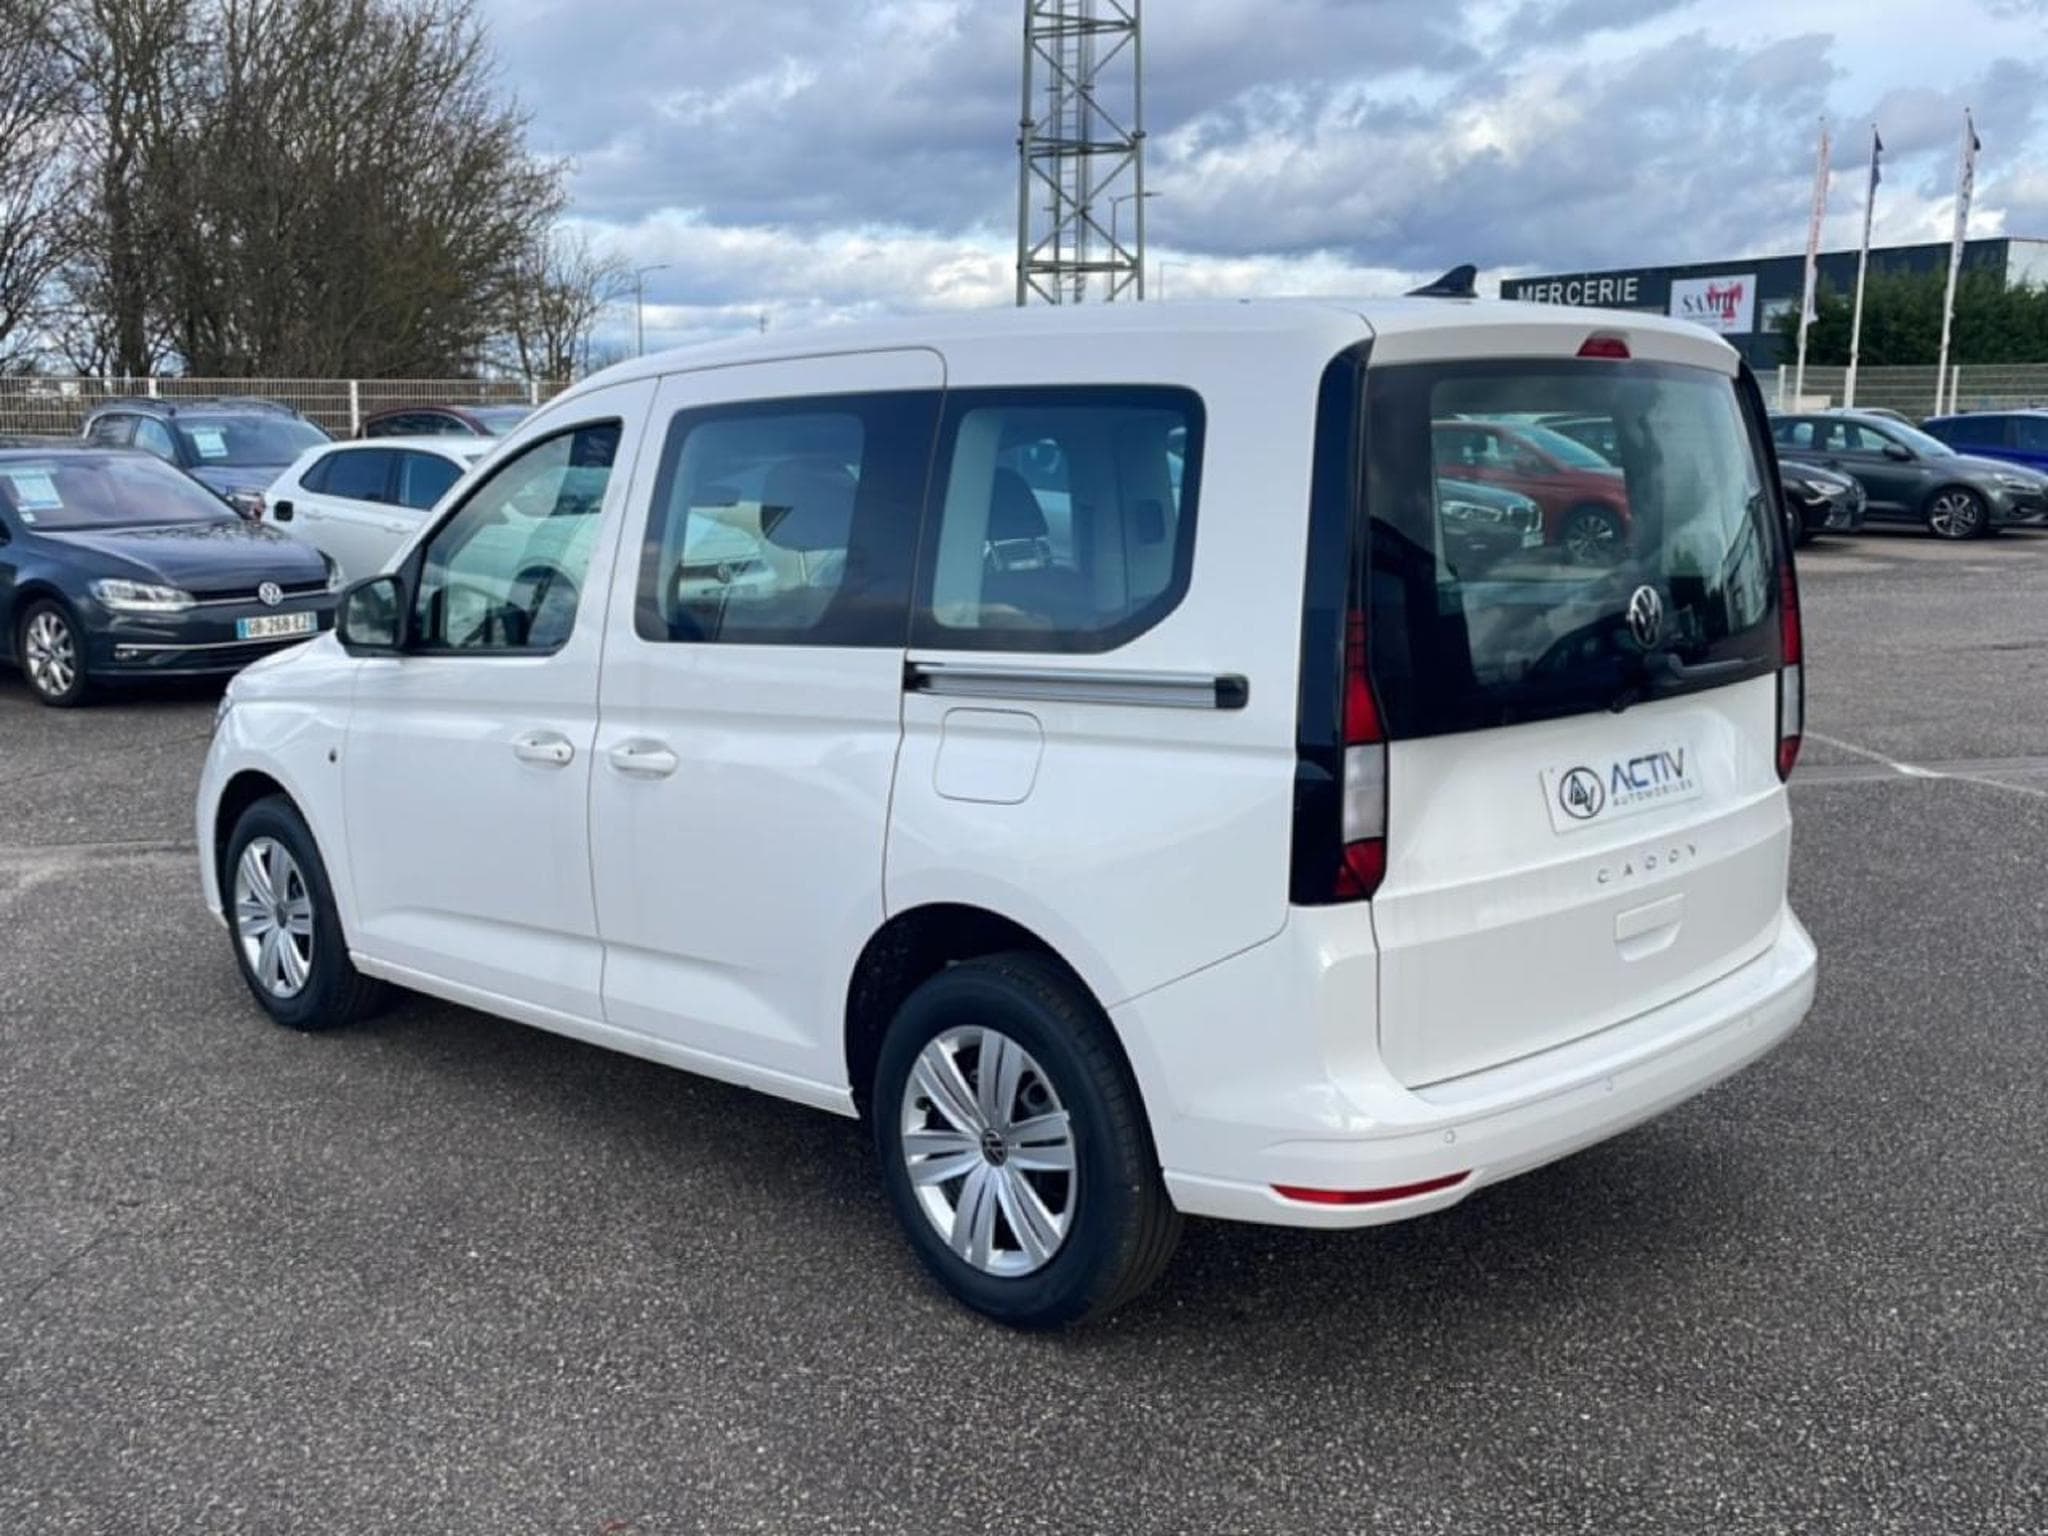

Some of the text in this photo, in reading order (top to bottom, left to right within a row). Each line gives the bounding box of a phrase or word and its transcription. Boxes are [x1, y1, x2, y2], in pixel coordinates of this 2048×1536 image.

[1517, 277, 1639, 304] MERCERIE
[1611, 747, 1684, 795] ACTIV
[1597, 843, 1697, 884] CADDY
